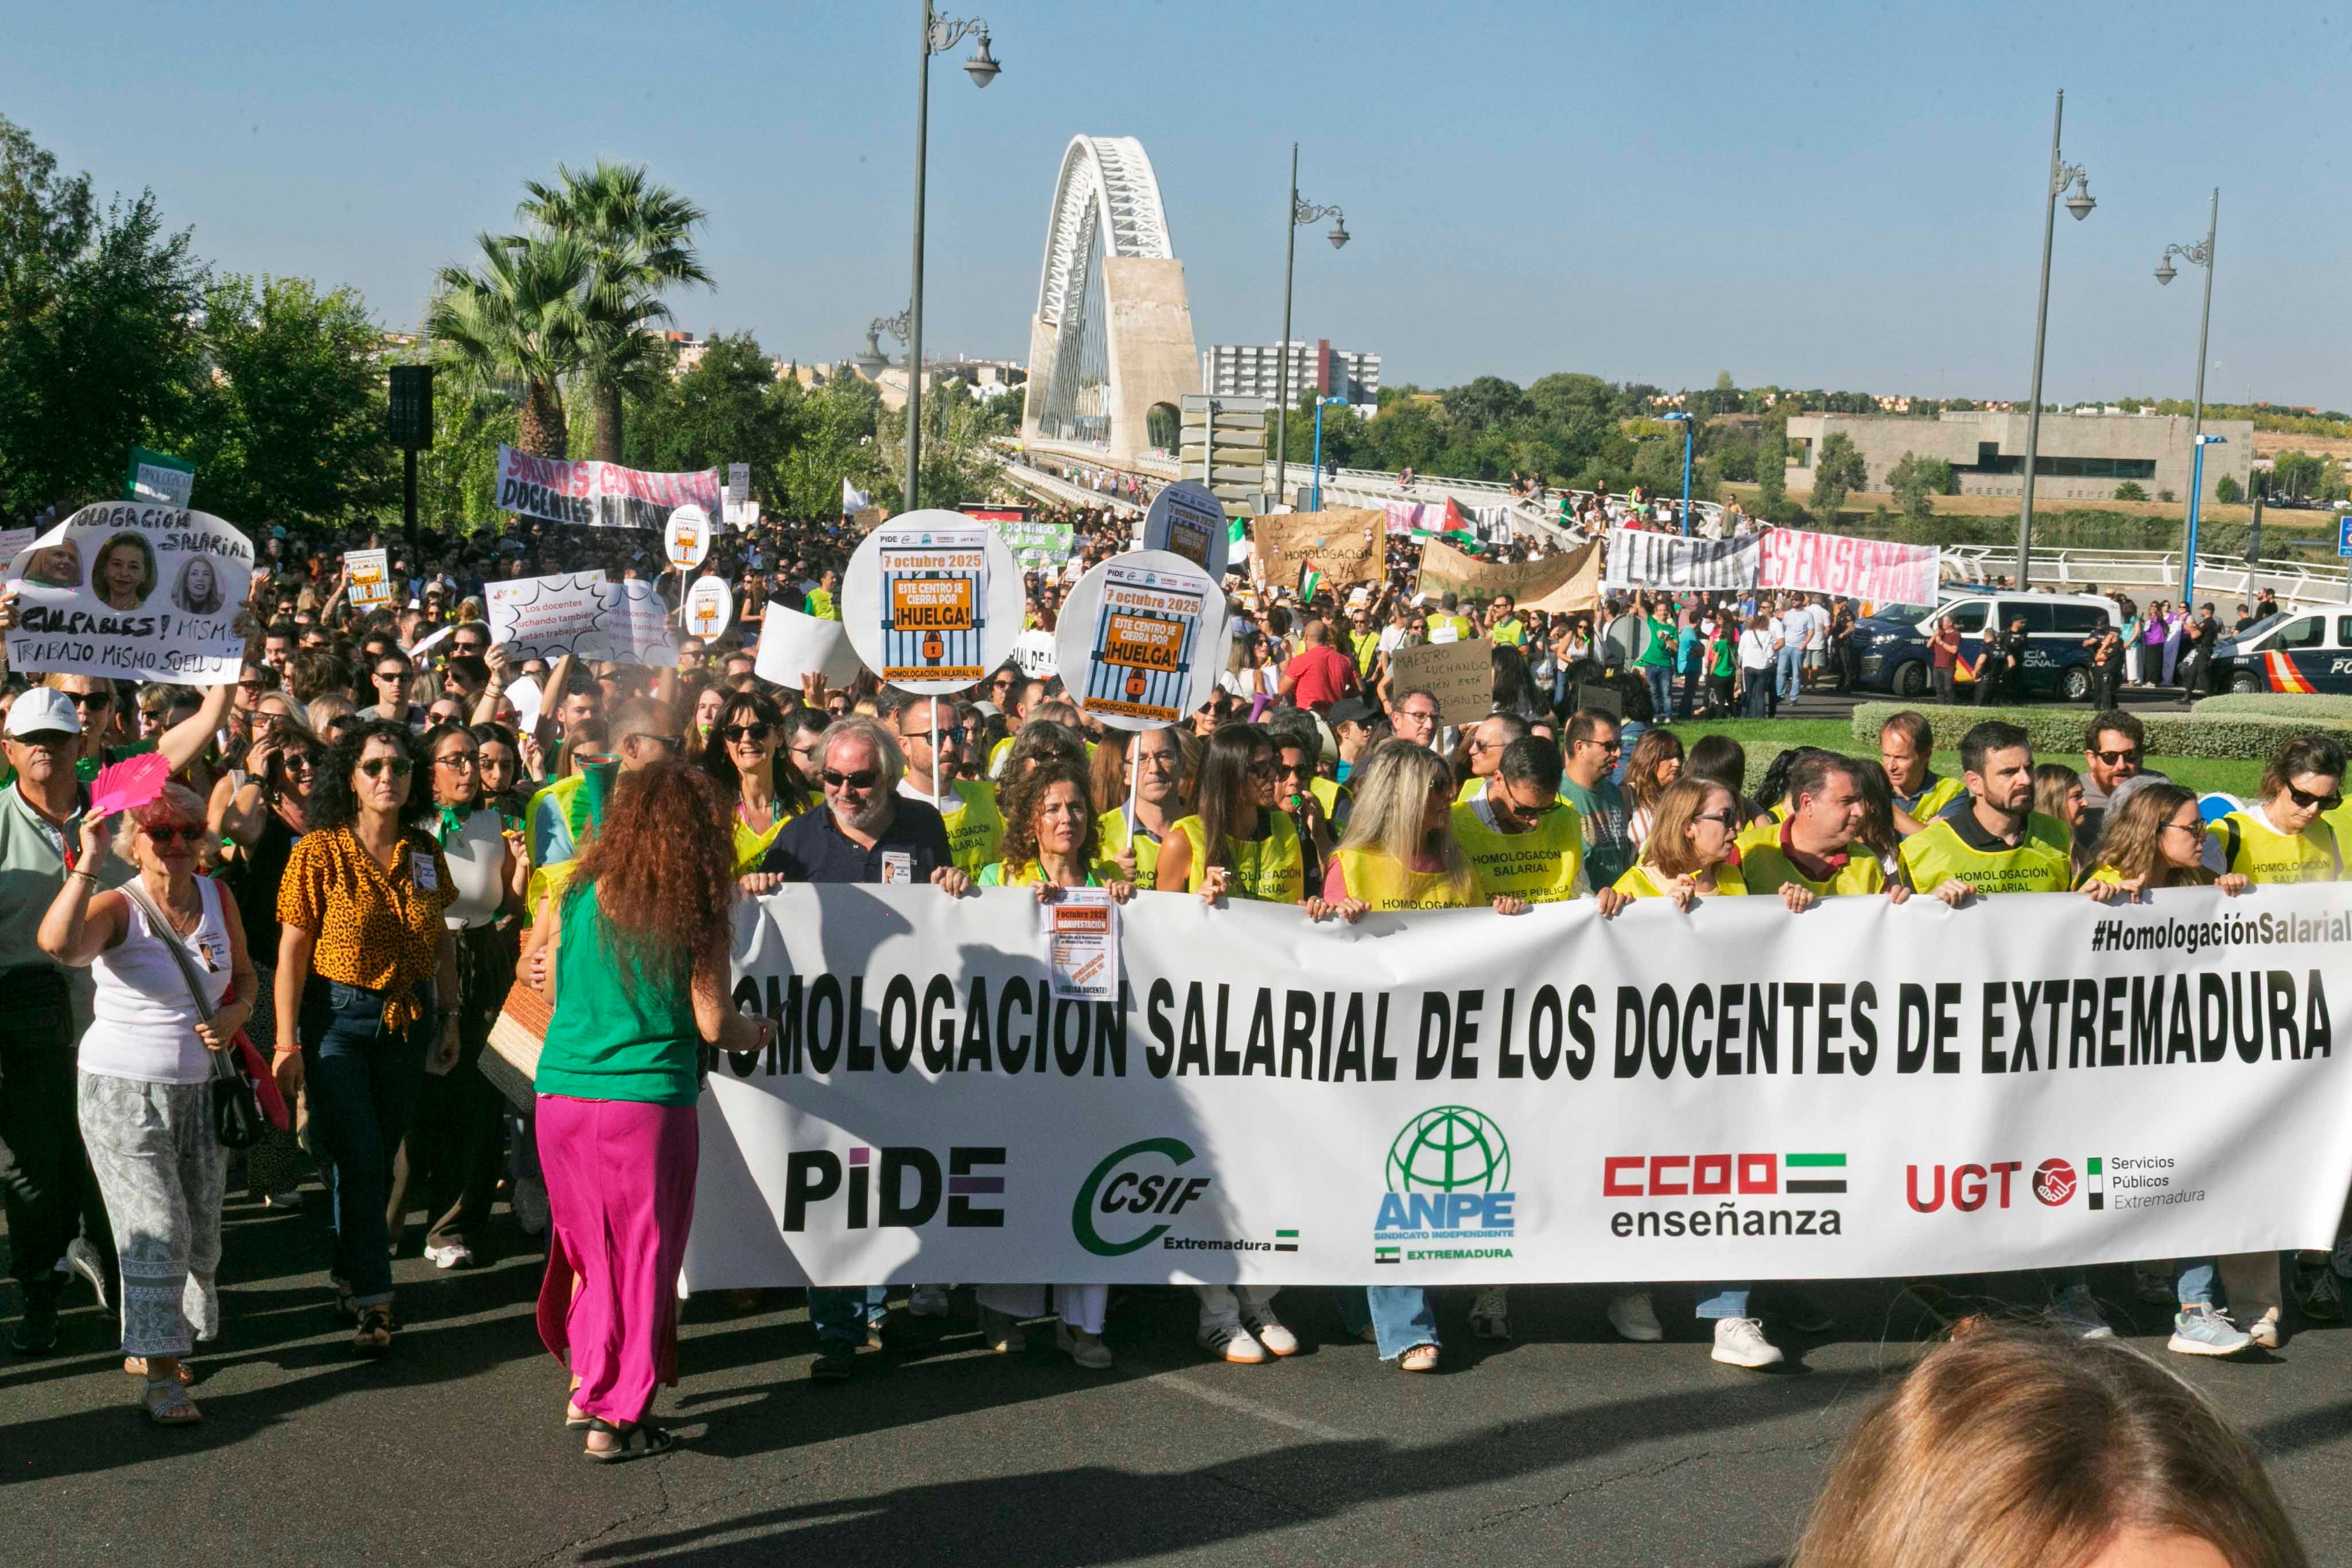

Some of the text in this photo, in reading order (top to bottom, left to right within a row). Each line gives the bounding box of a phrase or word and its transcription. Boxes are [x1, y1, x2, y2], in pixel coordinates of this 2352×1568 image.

[502, 479, 593, 523] DOCENTES
[884, 555, 982, 567] 7 octubre 2025
[898, 583, 963, 594] ESTE CENTRO SE
[524, 600, 582, 613] Los docentes
[907, 594, 957, 605] CIERRA POR
[1107, 589, 1198, 613] 7 octubre 2025
[516, 611, 594, 628] luchando también
[621, 608, 656, 618] docentes
[896, 607, 970, 626] ¡HUELGA!
[609, 621, 632, 629] hando
[1114, 618, 1177, 636] ESTE CENTRO SE
[520, 625, 593, 642] están trabajando
[1120, 630, 1169, 645] CIERRA POR
[1106, 641, 1178, 668] ¡HUELGA!
[1396, 649, 1449, 669] MAESTRO
[2024, 649, 2047, 658] ICÍA
[1426, 661, 1489, 675] LUCHANDO
[2022, 660, 2061, 668] ONAL
[941, 669, 969, 678] SALARIAL
[971, 669, 982, 677] YA!
[1458, 675, 1482, 686] ESTÁ
[1439, 693, 1491, 709] EÑANDO
[1139, 705, 1166, 718] SALARIAL
[946, 822, 991, 839] OLOGACIÓN
[949, 837, 986, 852] ALARIAL
[1494, 864, 1550, 876] SALARIAL
[1955, 867, 2048, 882] HOMOLOGACIÓN
[1485, 889, 1527, 900] DOCENTES
[1978, 883, 2032, 894] SALARIAL
[1382, 899, 1469, 910] HOMOLOGACIÓ
[1061, 910, 1088, 919] octubre
[1090, 910, 1107, 919] 2025
[1058, 919, 1106, 929] MANIFESTACIÓN
[2091, 912, 2352, 954] #HomologaciónSalarial
[697, 969, 2332, 1083] OMOLOGACIÓN SALARIAL DE LOS DOCENTES DE EXTREMADURA
[2111, 1156, 2174, 1170] Servicios
[1603, 1154, 1778, 1197] CCOO
[2113, 1175, 2169, 1189] Públicos
[1100, 1172, 1210, 1215] CSIF
[1906, 1161, 2022, 1213] UGT
[2115, 1189, 2205, 1210] Extremadura
[1374, 1192, 1516, 1230] ANPE
[1611, 1202, 1842, 1237] enseñanza
[1374, 1230, 1515, 1240] SINDICATO INDEPENDIENTE
[1163, 1236, 1271, 1252] Extremadura
[1407, 1248, 1514, 1260] EXTREMADURA
